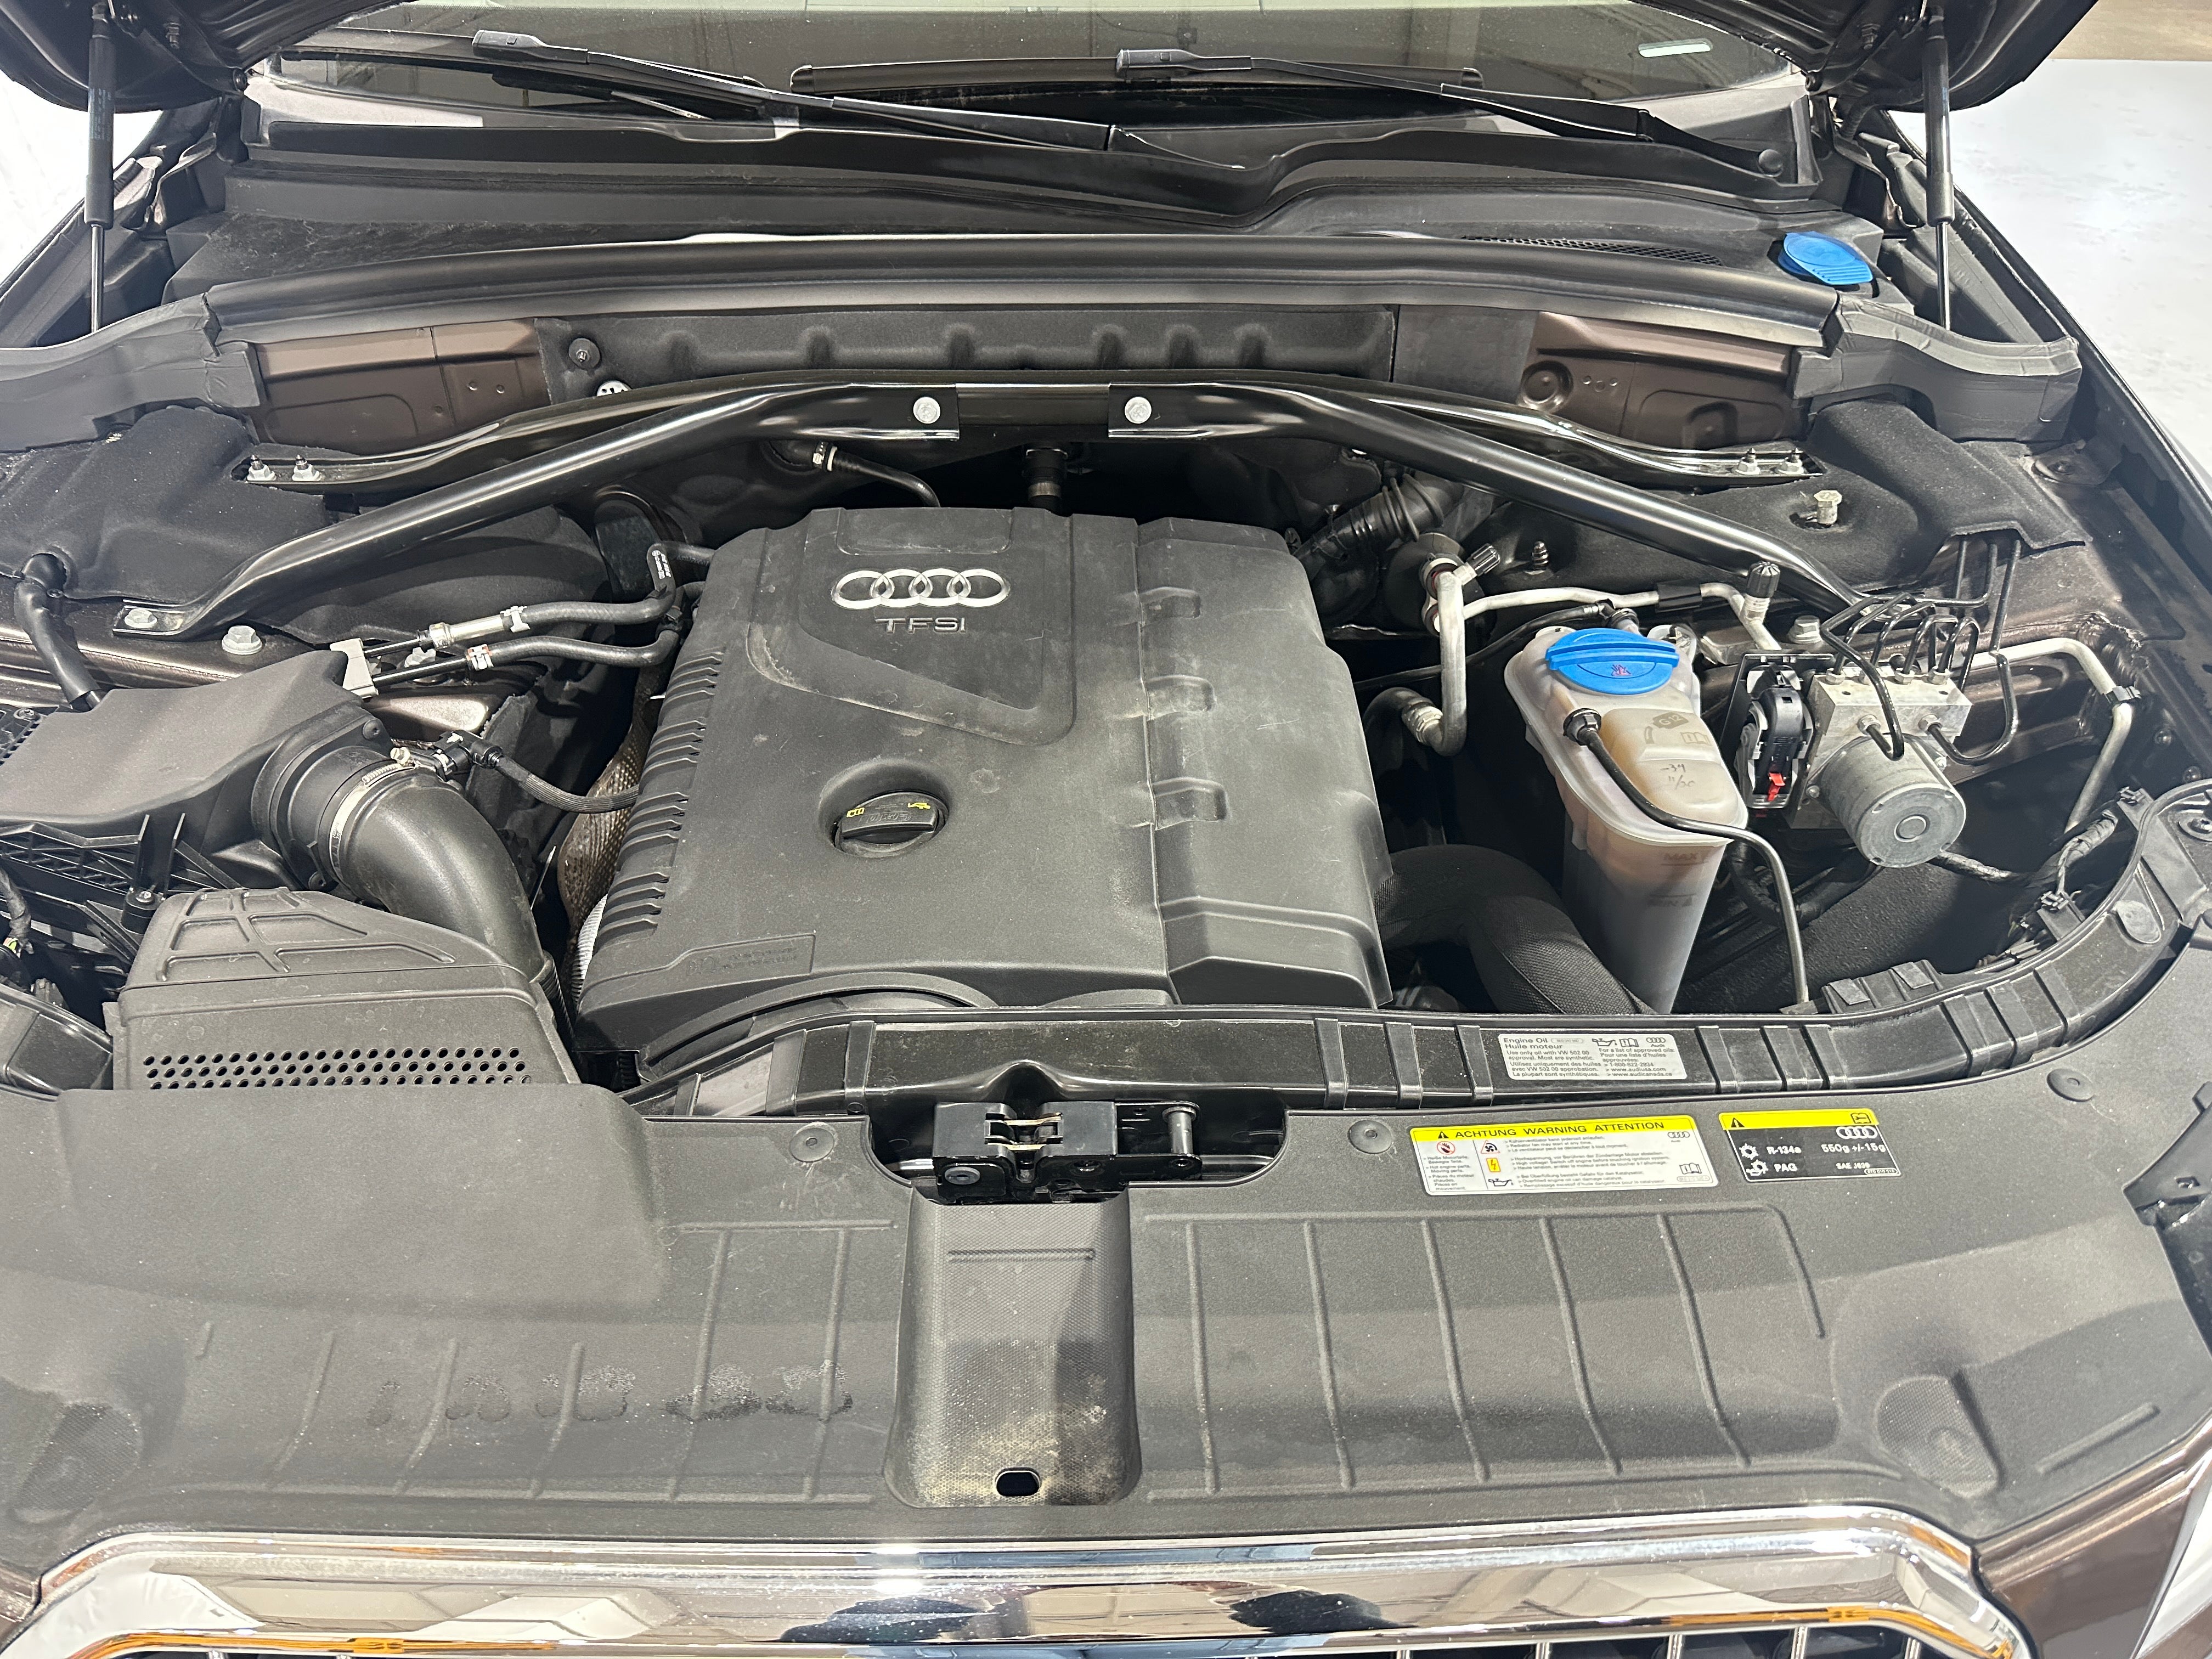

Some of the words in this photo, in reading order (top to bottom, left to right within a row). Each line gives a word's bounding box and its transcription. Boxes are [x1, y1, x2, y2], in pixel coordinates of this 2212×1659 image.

[874, 617, 966, 633] TFSI
[1658, 714, 1684, 725] G12
[1663, 853, 1698, 861] MAX
[1455, 1128, 1516, 1138] ACHTUNG
[1523, 1125, 1587, 1135] WARNING
[1594, 1121, 1664, 1132] ATTENTION
[1766, 1146, 1802, 1154] R-134a
[1821, 1144, 1850, 1153] 550g
[1852, 1143, 1886, 1153] +/-15g
[1774, 1163, 1798, 1172] PAG
